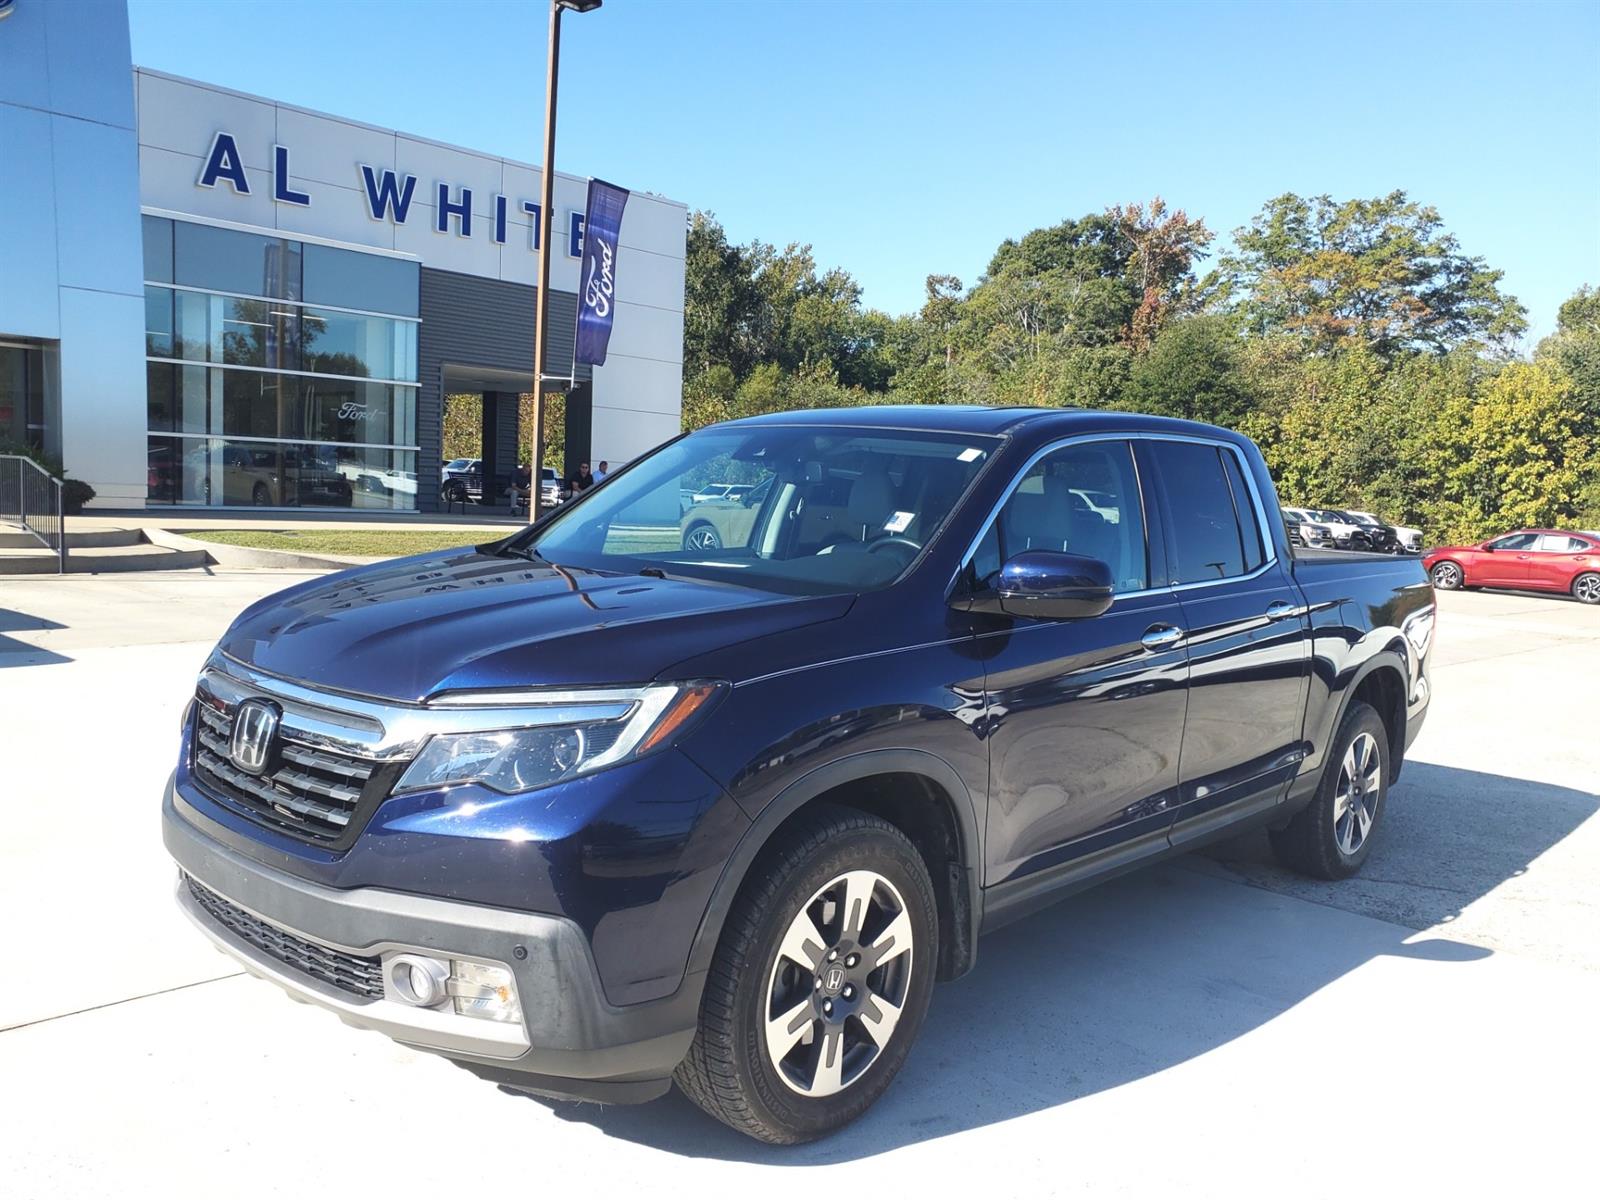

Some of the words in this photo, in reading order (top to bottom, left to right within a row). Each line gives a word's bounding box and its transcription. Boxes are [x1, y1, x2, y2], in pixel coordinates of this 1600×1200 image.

[199, 132, 311, 206] AL
[585, 237, 614, 317] Ford
[337, 402, 378, 420] Ford
